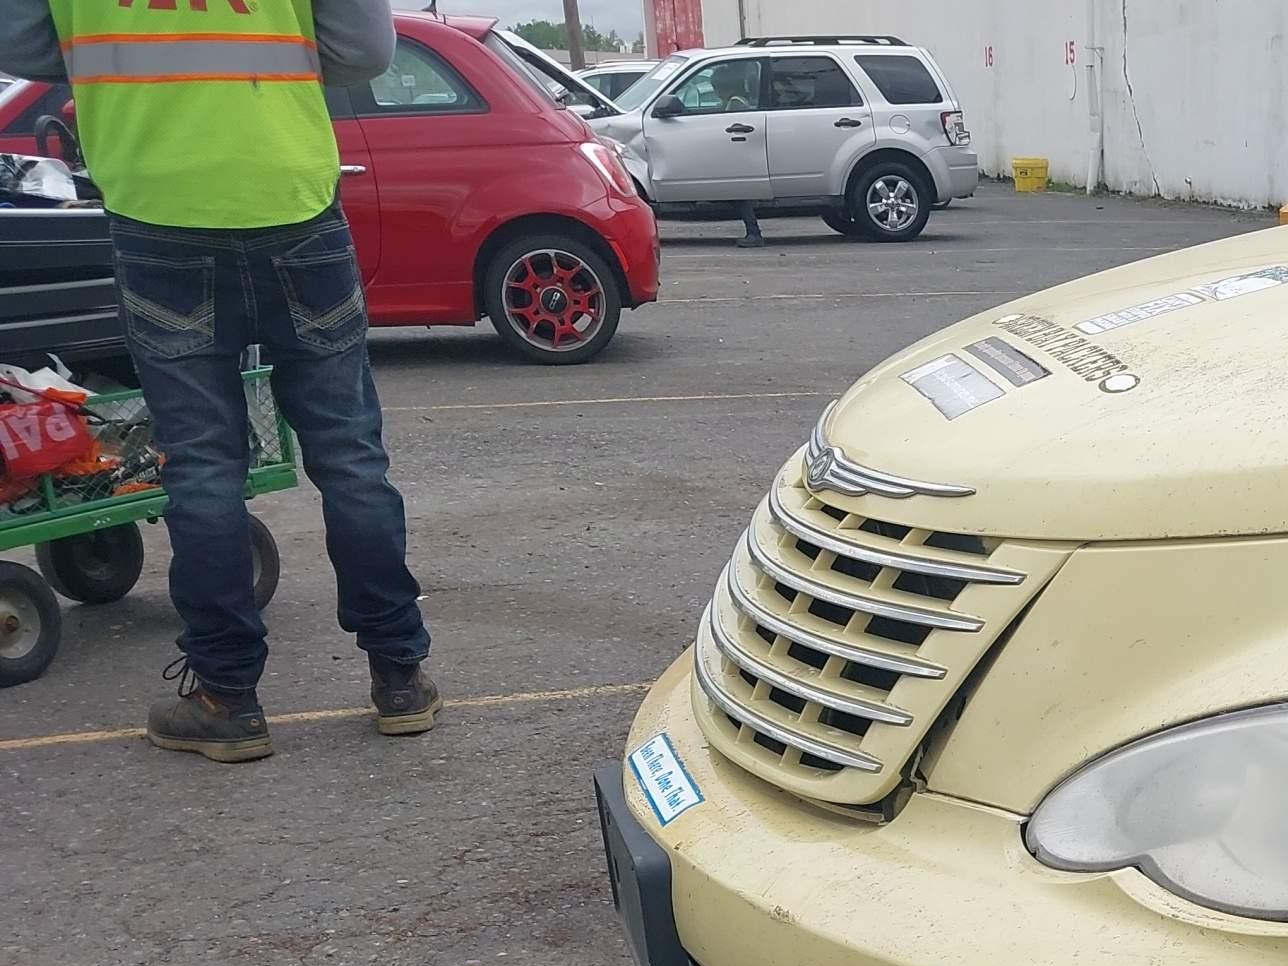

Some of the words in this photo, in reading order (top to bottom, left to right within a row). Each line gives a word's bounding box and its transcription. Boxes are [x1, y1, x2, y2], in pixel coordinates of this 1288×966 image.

[984, 46, 994, 67] 16
[1065, 40, 1076, 65] 15
[1044, 338, 1129, 382] PACKERS
[646, 753, 664, 779] There,
[654, 770, 673, 794] Done
[664, 786, 686, 813] That.
